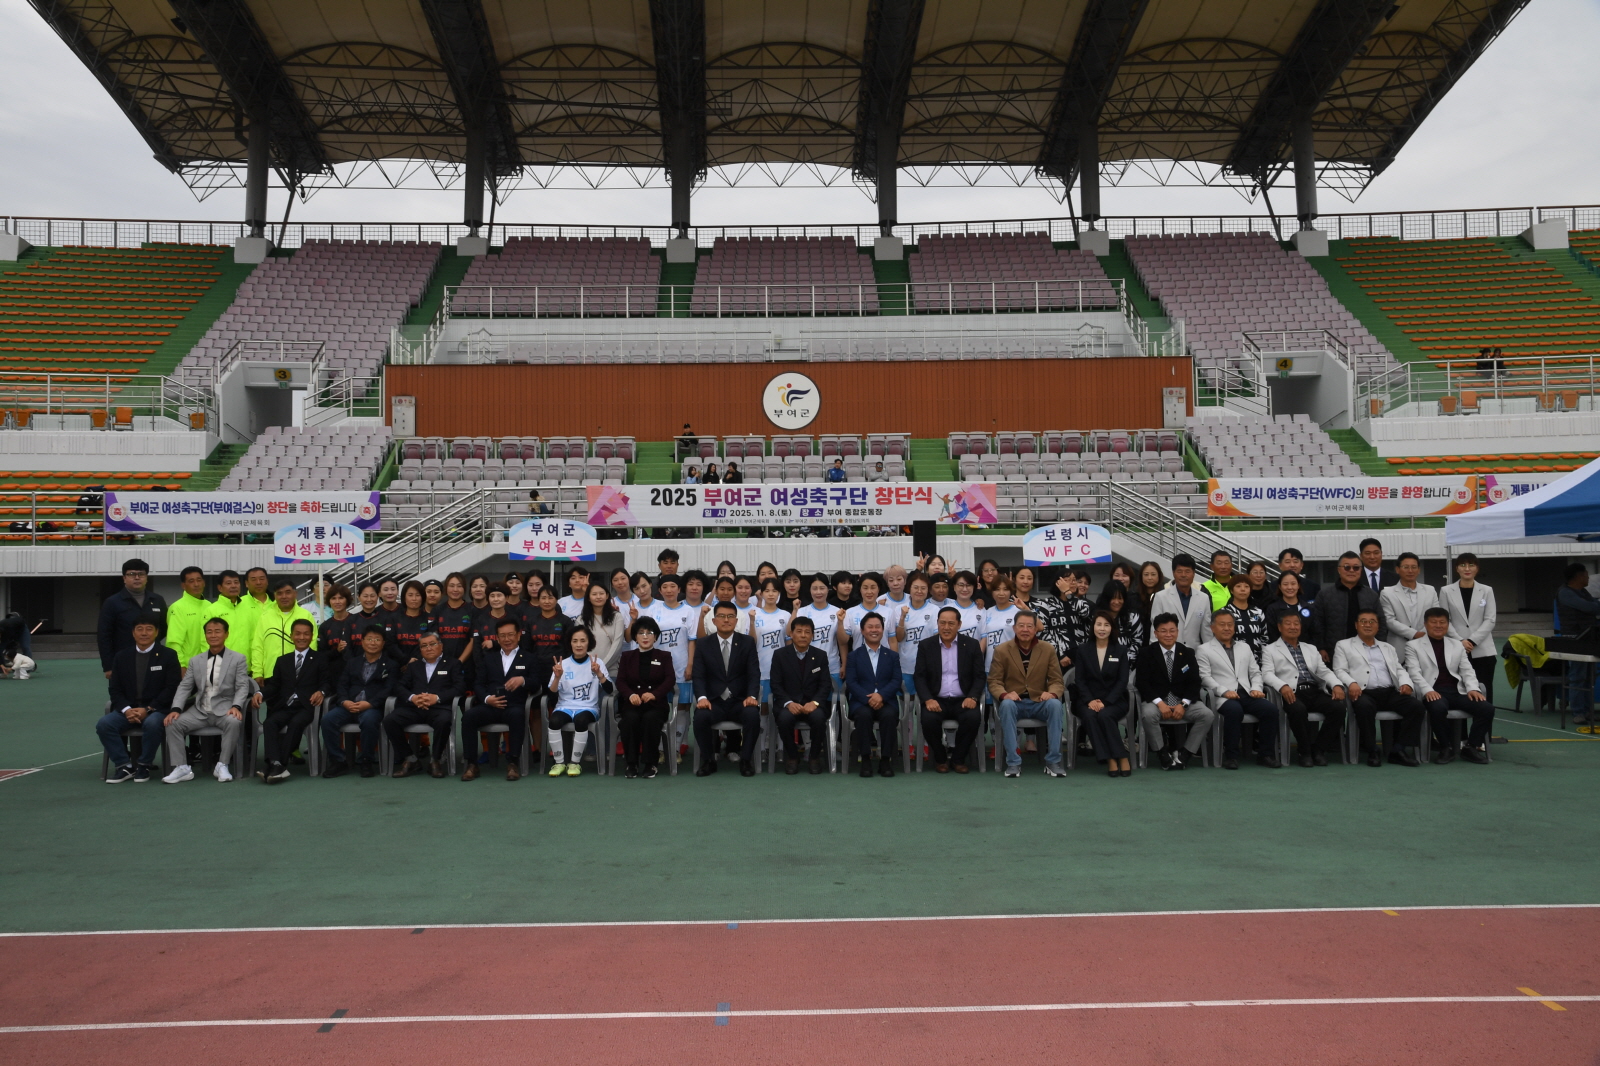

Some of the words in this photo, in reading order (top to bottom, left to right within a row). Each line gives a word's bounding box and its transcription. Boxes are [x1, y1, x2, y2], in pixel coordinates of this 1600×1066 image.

[1280, 360, 1288, 368] 4
[277, 370, 287, 379] 3
[774, 409, 809, 418] 부여군
[650, 488, 697, 506] 2025
[704, 488, 762, 506] 부여군
[770, 487, 868, 506] 여성축구단
[875, 487, 932, 505] 창단식
[1231, 487, 1263, 500] 보령시
[1266, 487, 1364, 500] 여성축구단(WFC)의
[1367, 486, 1398, 500] 방문을
[1401, 485, 1451, 499] 환영합니다
[130, 501, 159, 515] 부여군
[162, 501, 264, 515] 여성축구단(부여걸스)의
[267, 501, 297, 514] 창단을
[301, 501, 357, 514] 축하드립니다
[729, 509, 753, 517] 2025.
[757, 509, 766, 517] 11.
[845, 508, 883, 516] 종합운동장
[1325, 504, 1365, 512] 부여군체육회
[297, 526, 342, 539] 계룡시
[530, 523, 575, 536] 부여군
[1044, 527, 1088, 541] 보령시
[284, 543, 355, 556] 여성후레쉬
[522, 540, 583, 553] 부여걸스
[660, 627, 681, 644] BY
[762, 630, 781, 647] BY
[906, 626, 924, 642] BY
[565, 672, 574, 680] 20
[573, 682, 592, 699] BY
